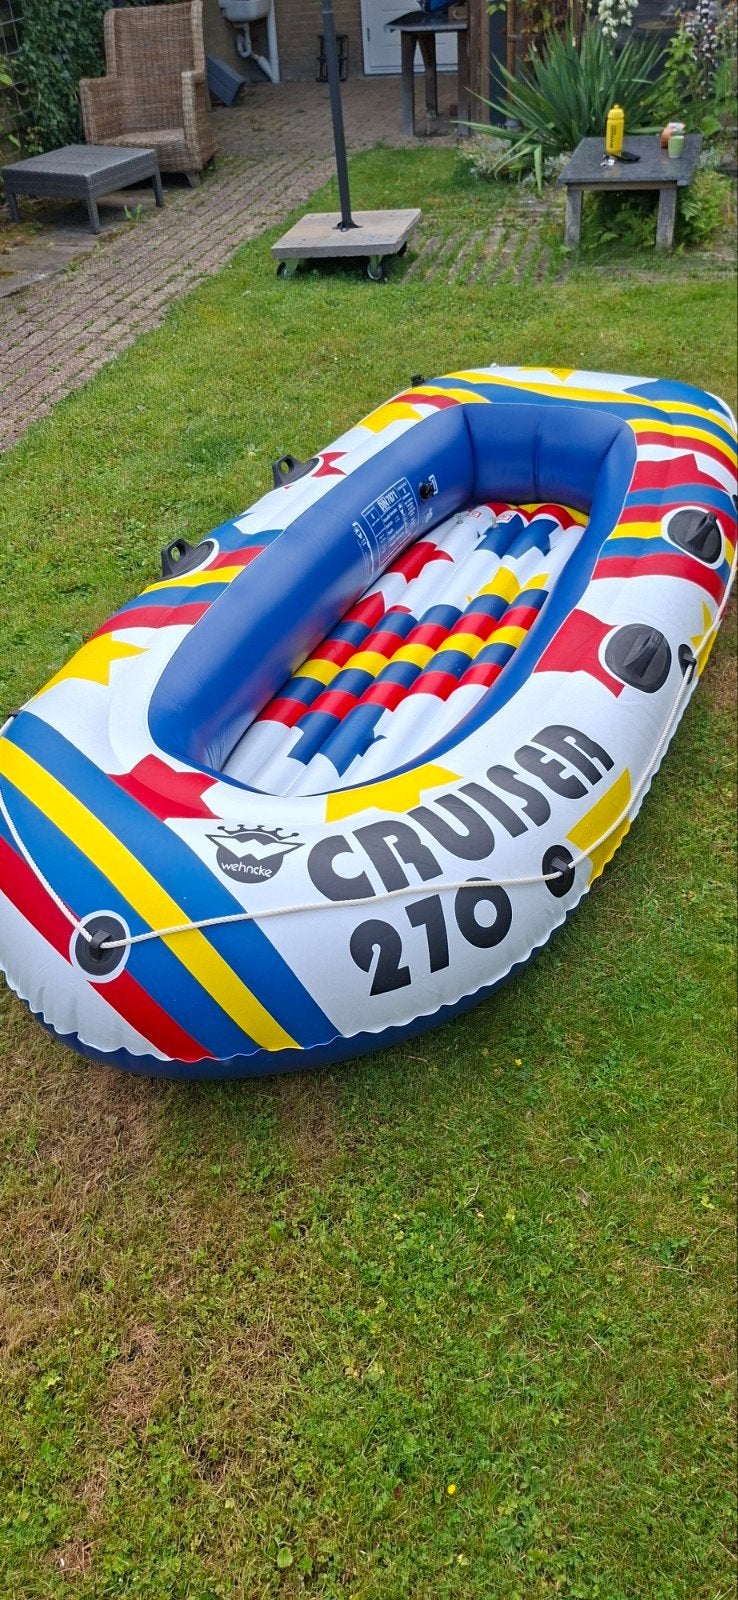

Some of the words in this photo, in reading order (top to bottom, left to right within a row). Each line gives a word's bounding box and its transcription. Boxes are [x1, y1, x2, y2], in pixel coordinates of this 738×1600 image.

[221, 862, 273, 878] wehncke
[307, 725, 614, 901] CRUISER
[350, 877, 512, 996] 270
